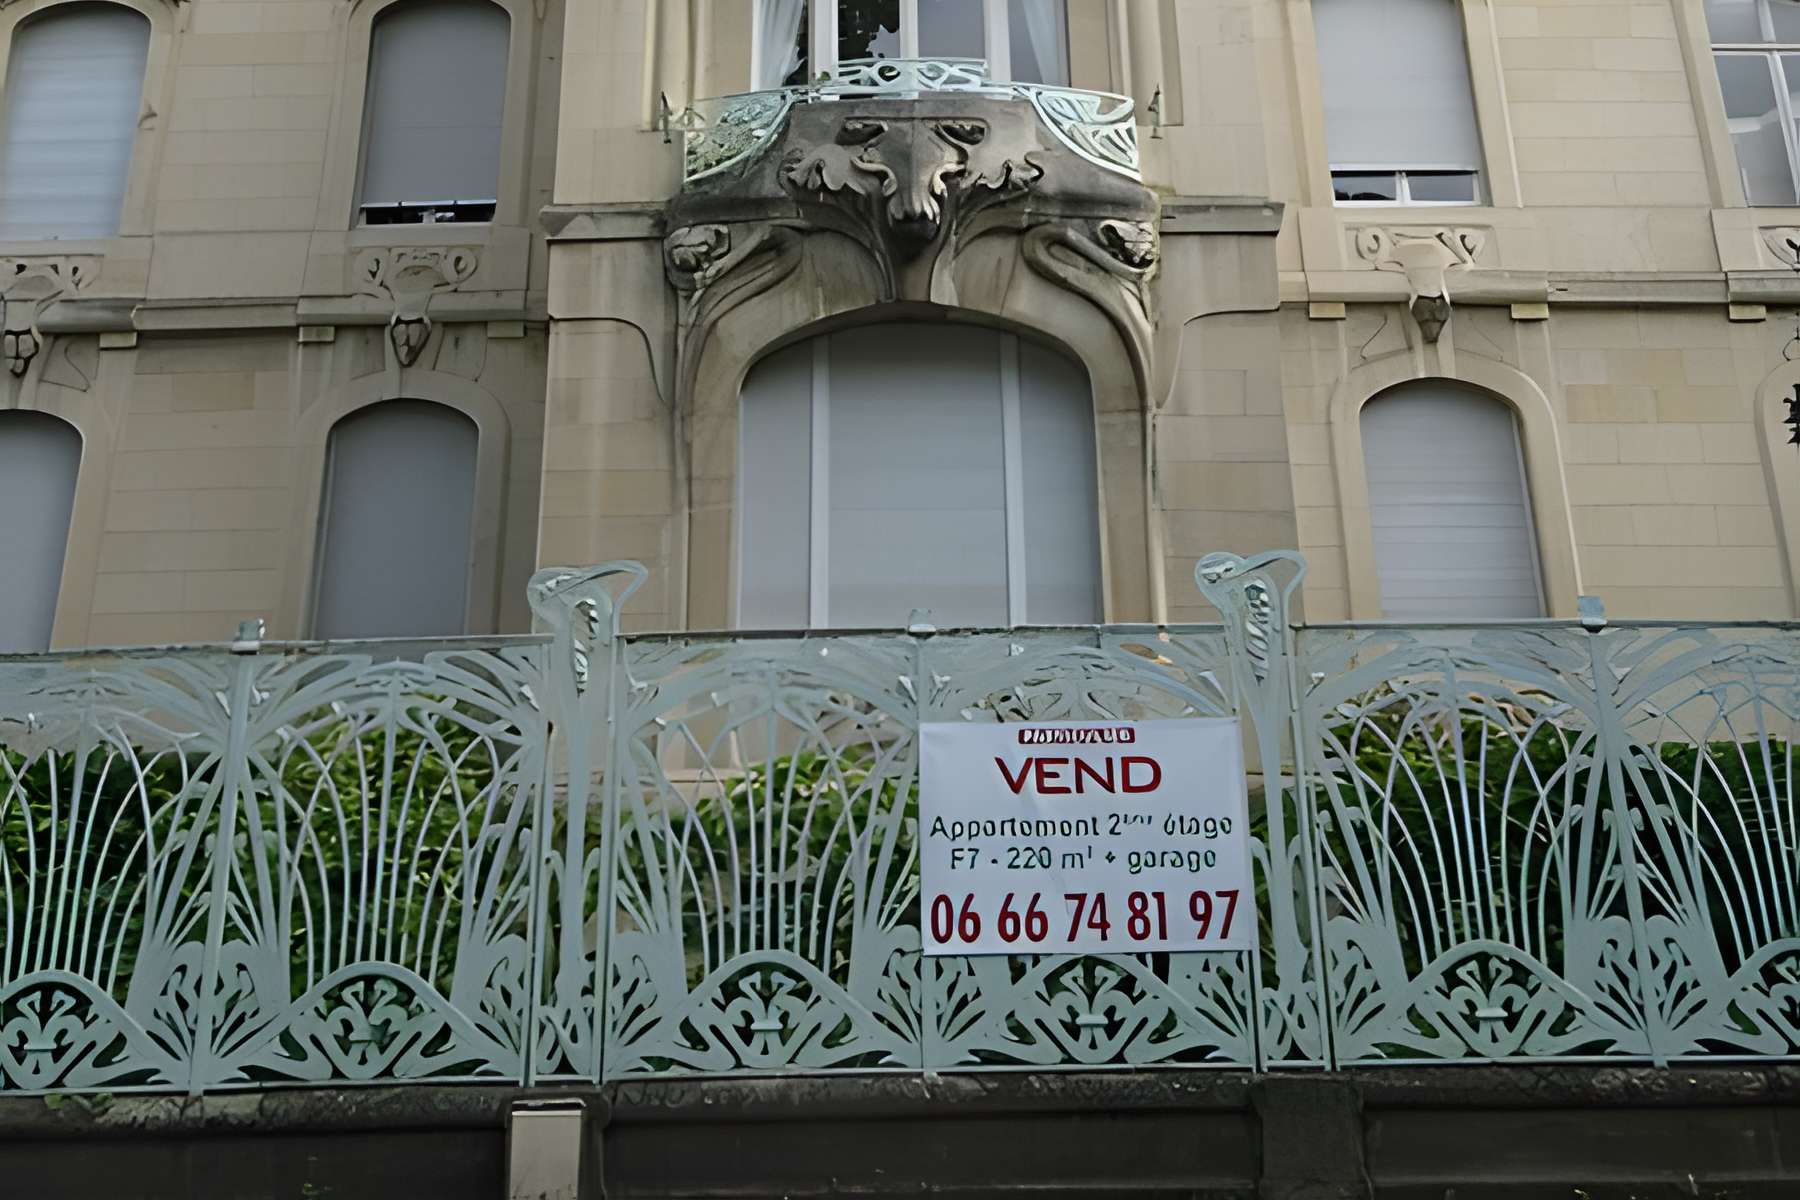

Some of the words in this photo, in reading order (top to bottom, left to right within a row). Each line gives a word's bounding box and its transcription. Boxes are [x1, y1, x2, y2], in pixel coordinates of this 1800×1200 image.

[994, 756, 1161, 794] VEND
[951, 848, 980, 870] F7
[1007, 846, 1051, 869] 220
[931, 893, 981, 944] 06
[997, 892, 1049, 943] 66
[1064, 892, 1111, 942] 74
[1127, 891, 1168, 940] 81
[1189, 889, 1239, 939] 97
